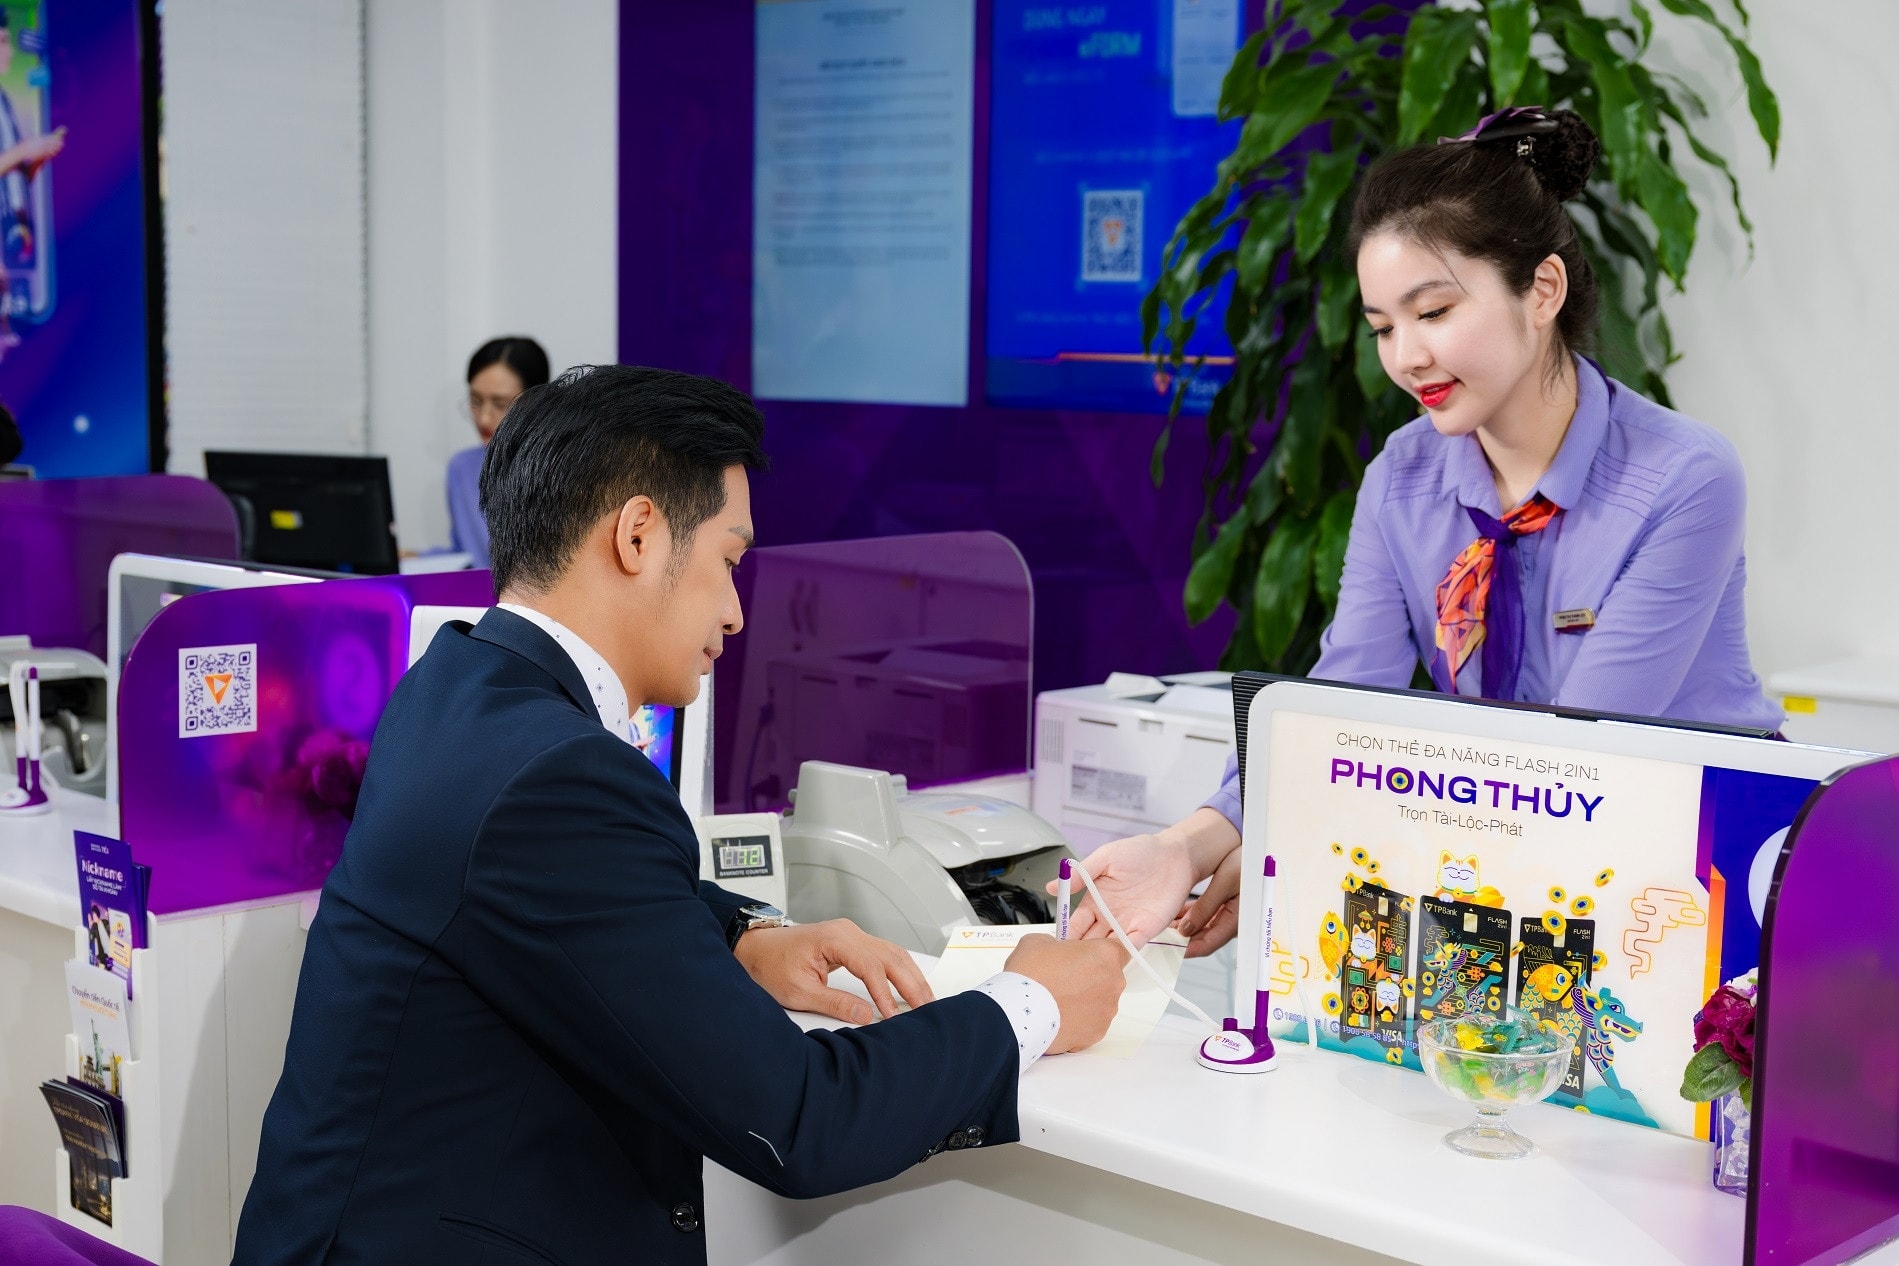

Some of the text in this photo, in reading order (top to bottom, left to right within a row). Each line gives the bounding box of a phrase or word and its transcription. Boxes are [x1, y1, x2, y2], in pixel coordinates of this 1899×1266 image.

[1336, 733, 1600, 781] CHỌN THẺ ĐA NĂNG FLASH 2IN1
[1330, 757, 1604, 822] PHONG THỦY
[1398, 804, 1523, 837] Trọn Tài-Lộc-Phát
[82, 860, 123, 882] Nickname
[720, 869, 745, 877] BANKNOTE
[1434, 904, 1458, 917] TPBank
[1487, 916, 1508, 925] FLASH
[1381, 1029, 1402, 1042] VISA
[1221, 1037, 1241, 1048] TPBank
